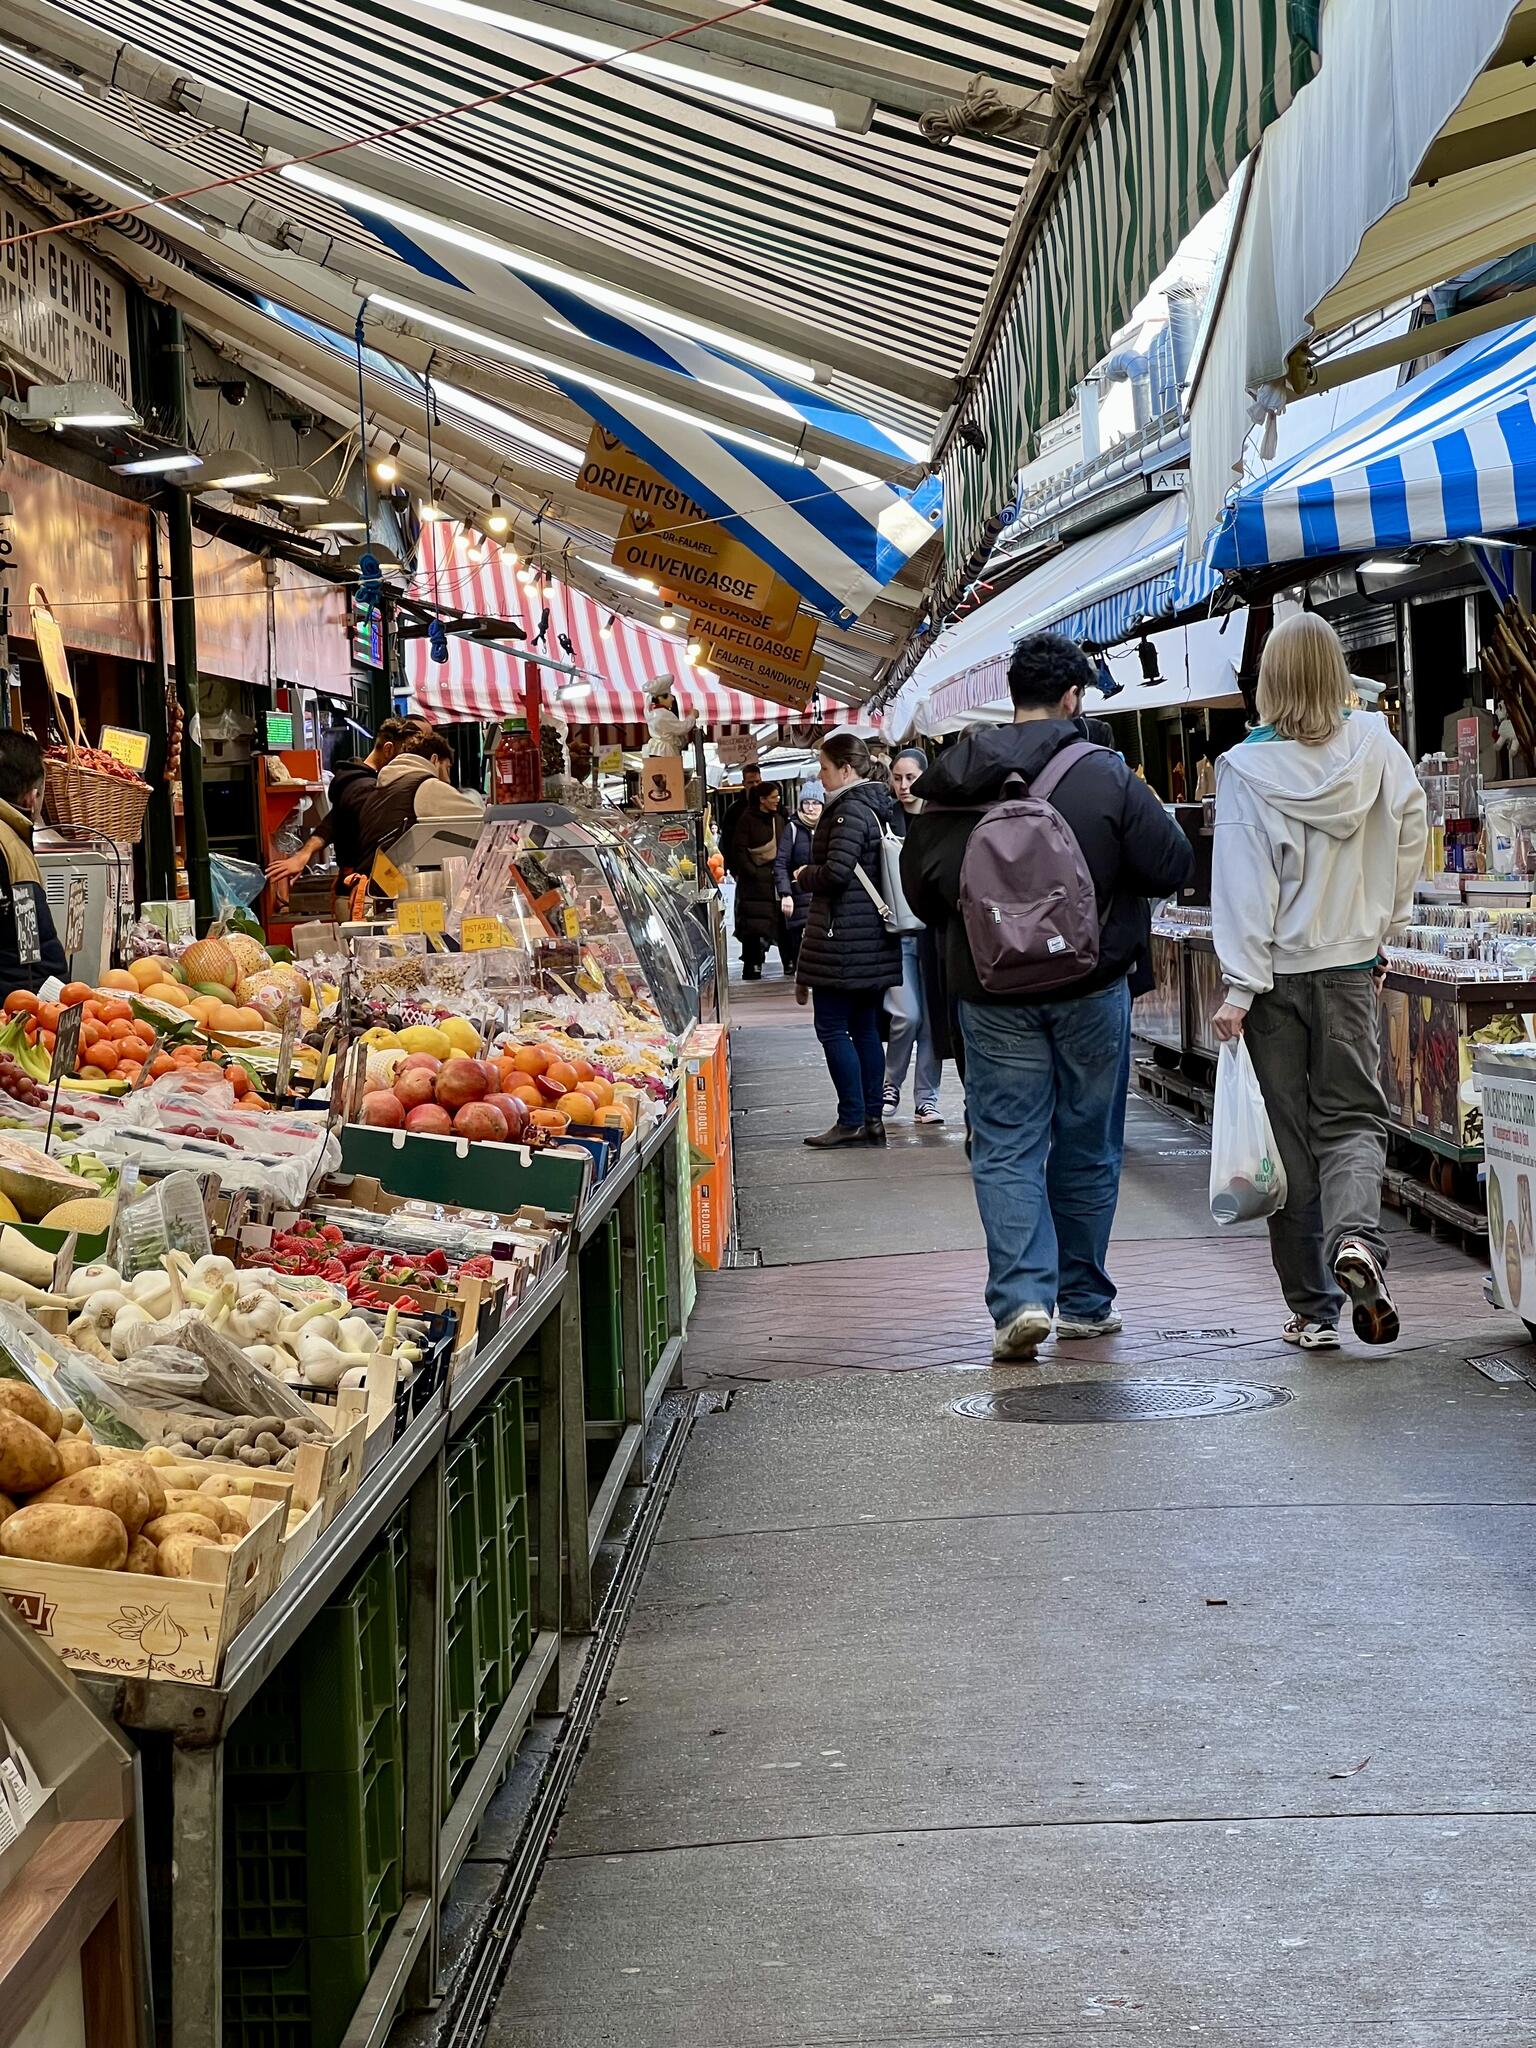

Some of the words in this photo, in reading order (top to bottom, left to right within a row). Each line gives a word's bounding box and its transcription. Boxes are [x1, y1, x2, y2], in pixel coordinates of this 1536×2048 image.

[0, 210, 112, 338] BST-GEMÜSE
[584, 463, 712, 521] ORIENTSTR
[1157, 475, 1168, 487] A
[1173, 473, 1184, 486] 13
[627, 546, 758, 600] OLIVENGASSE
[694, 618, 803, 663] FALAFELGASSE
[715, 649, 755, 672] FALAFEL
[757, 664, 811, 693] SANDWICH
[701, 1202, 711, 1238] MEDJOOL
